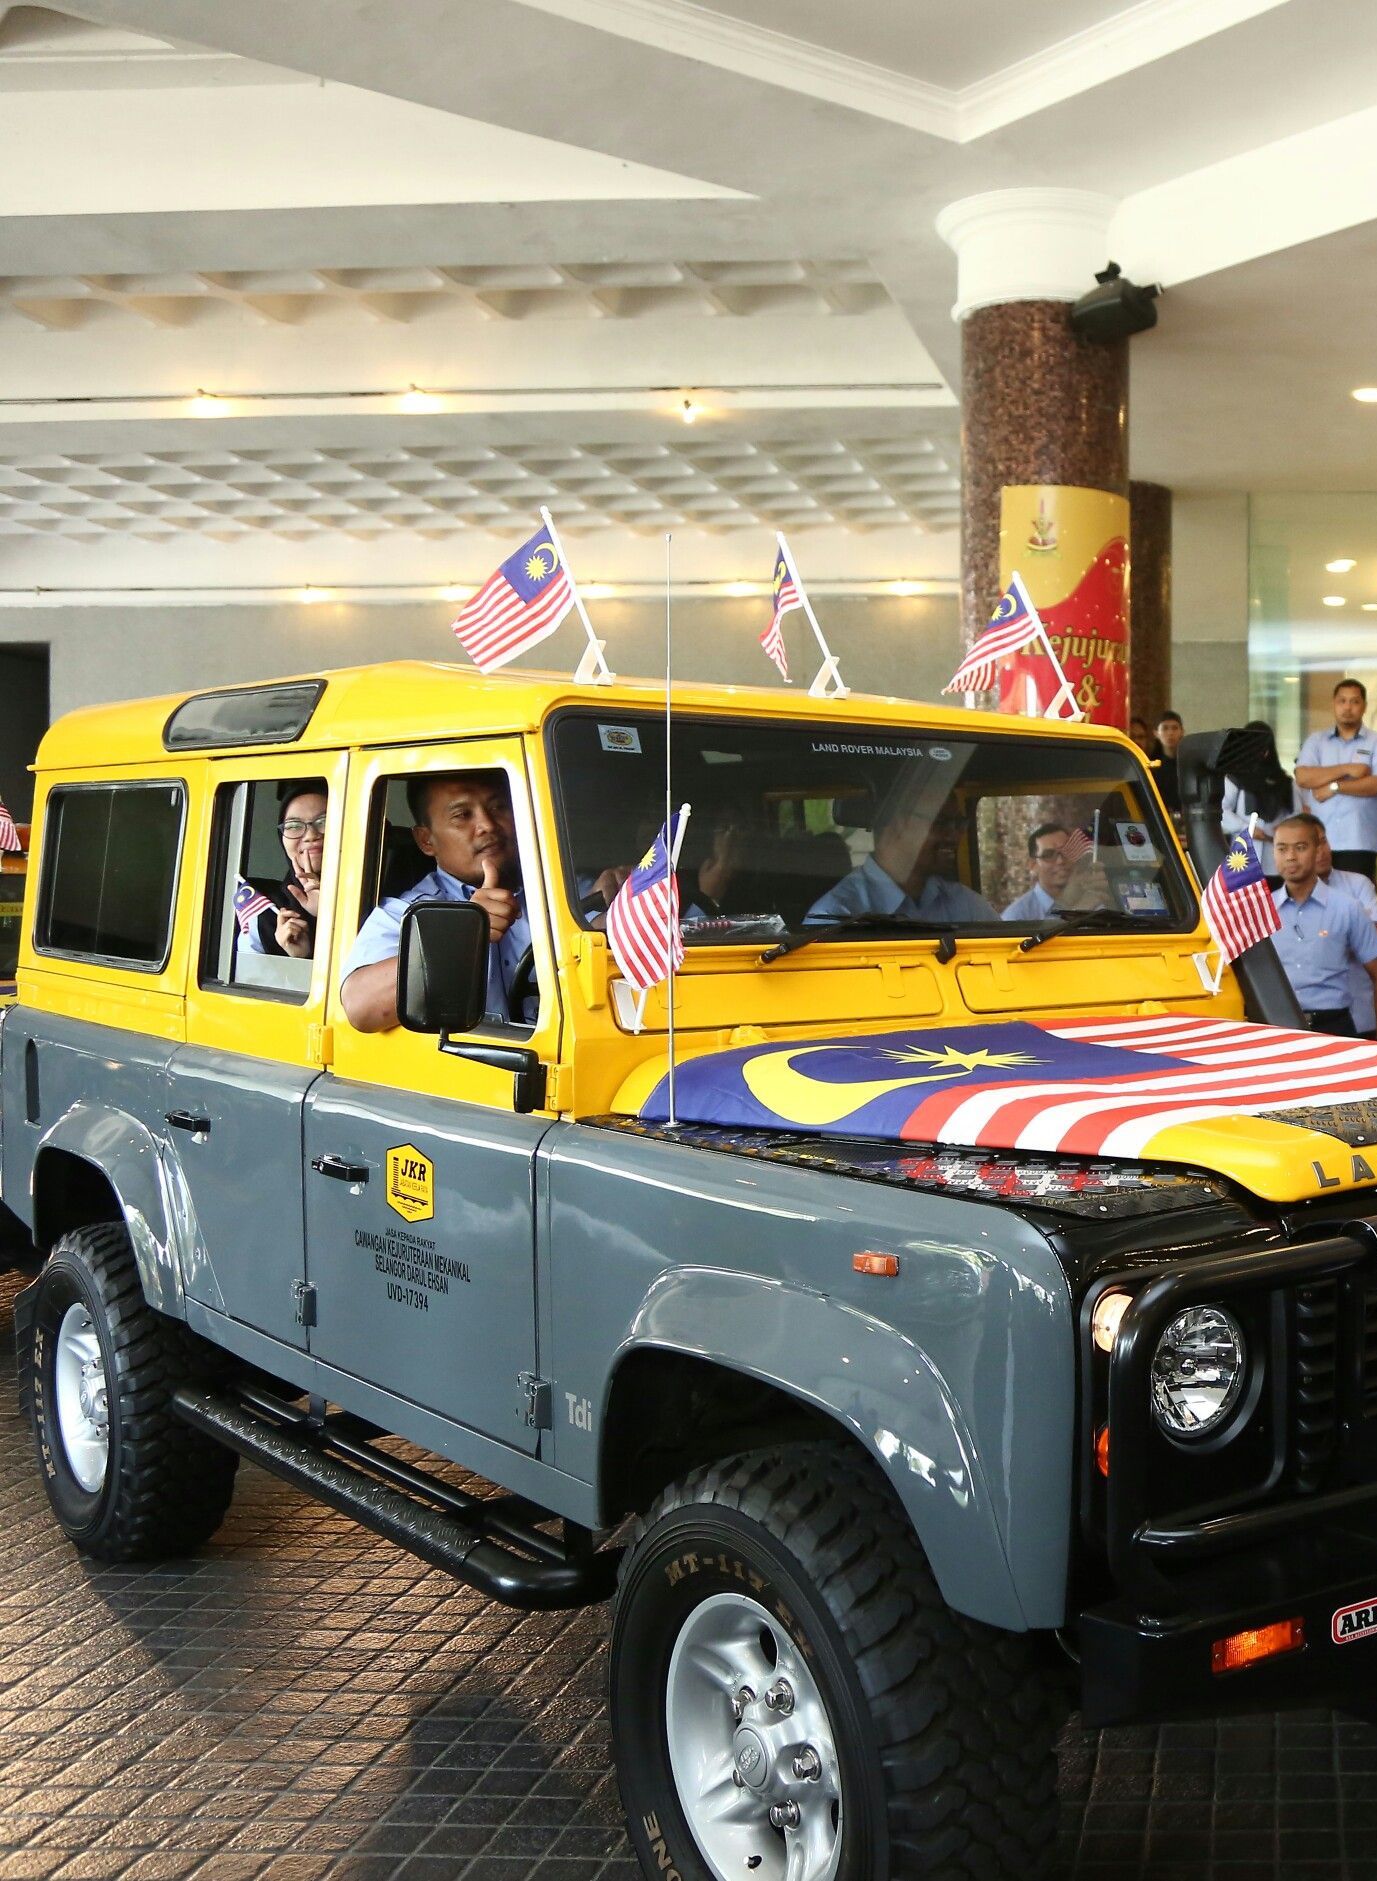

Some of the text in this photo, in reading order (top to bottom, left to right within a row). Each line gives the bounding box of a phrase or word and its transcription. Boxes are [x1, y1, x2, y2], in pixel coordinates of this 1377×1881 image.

[812, 743, 839, 753] LAND
[841, 744, 874, 755] ROVER
[875, 746, 924, 758] MALAYSIA
[401, 1159, 427, 1182] JKR
[354, 1229, 471, 1282] CAWANGAN KEJURUTERAAN MEKANIKAL
[375, 1254, 449, 1294] SELANGOR DARUL EHSAN
[565, 1392, 592, 1432] Tdi
